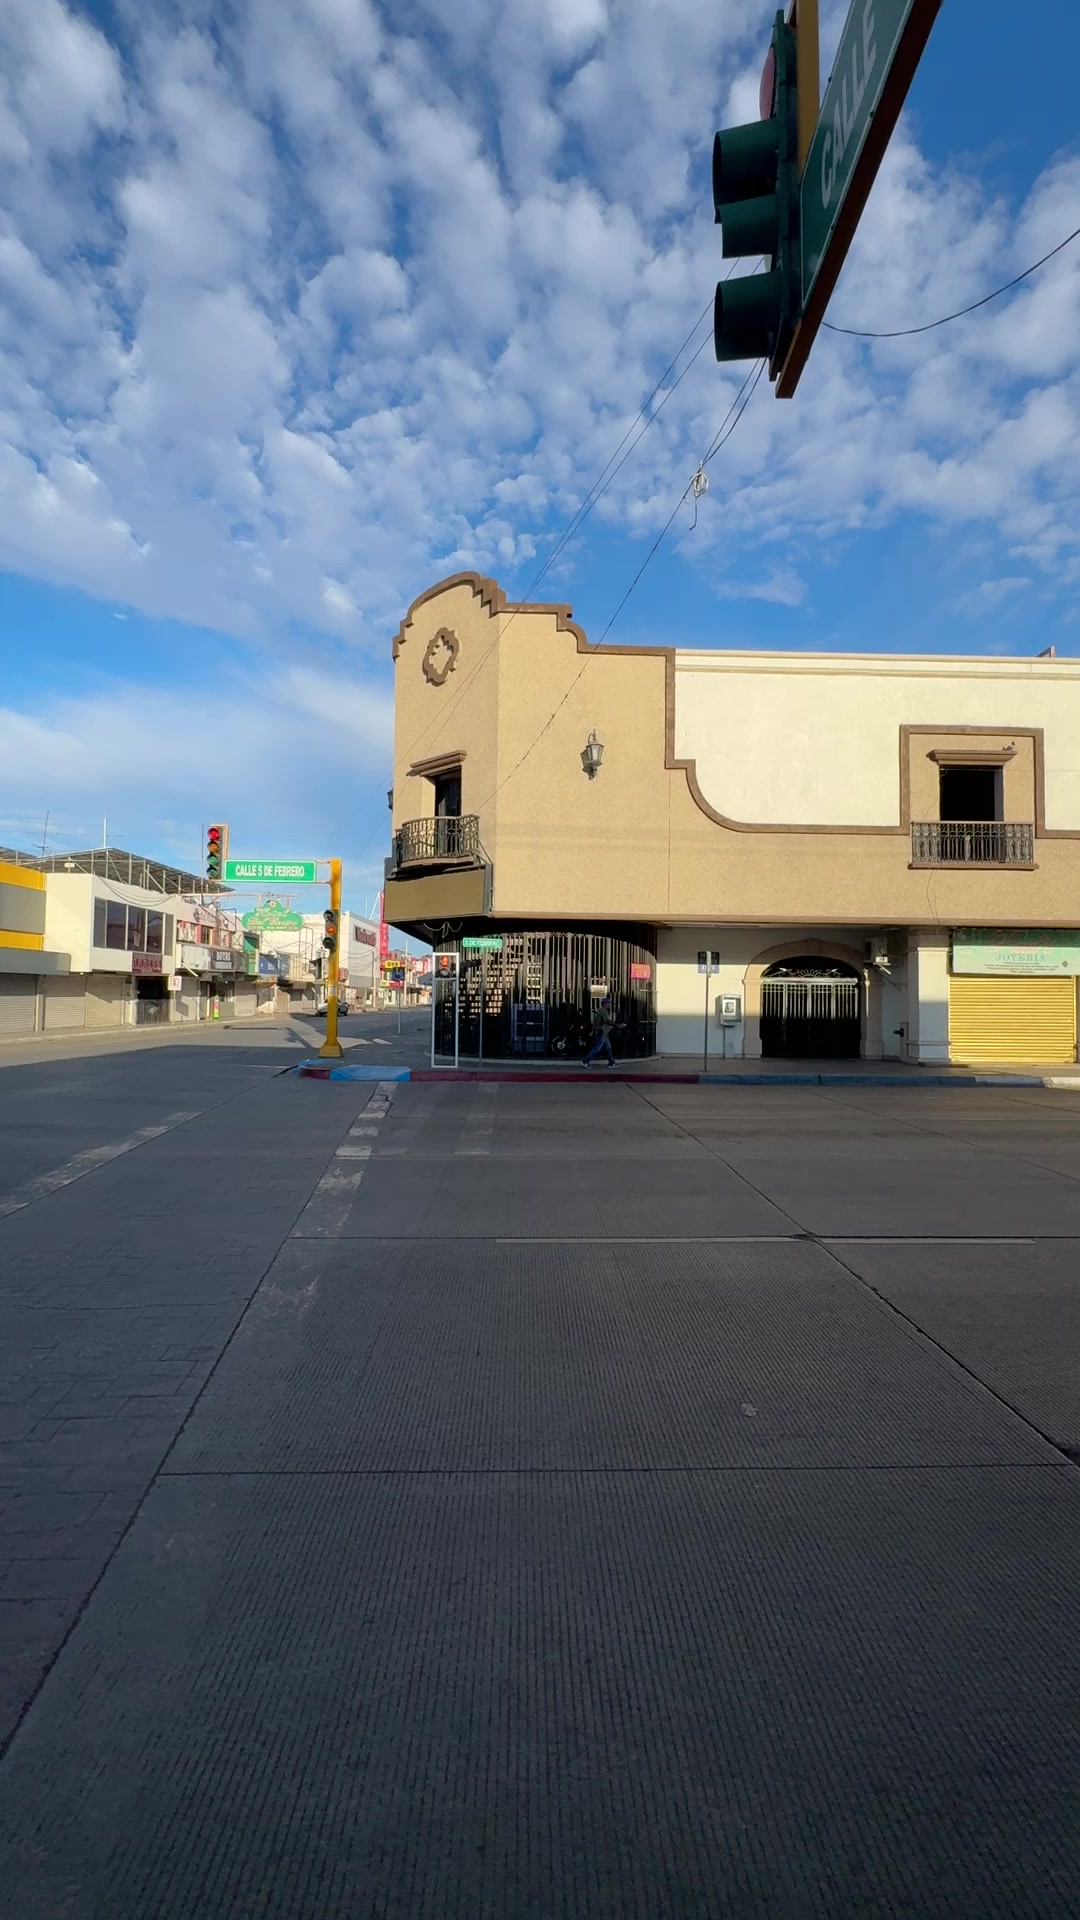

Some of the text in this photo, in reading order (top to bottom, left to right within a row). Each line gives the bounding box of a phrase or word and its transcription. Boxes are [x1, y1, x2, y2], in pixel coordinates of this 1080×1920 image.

[821, 0, 877, 209] CALLE
[235, 864, 305, 878] CALLE 5 DE FEBRERO
